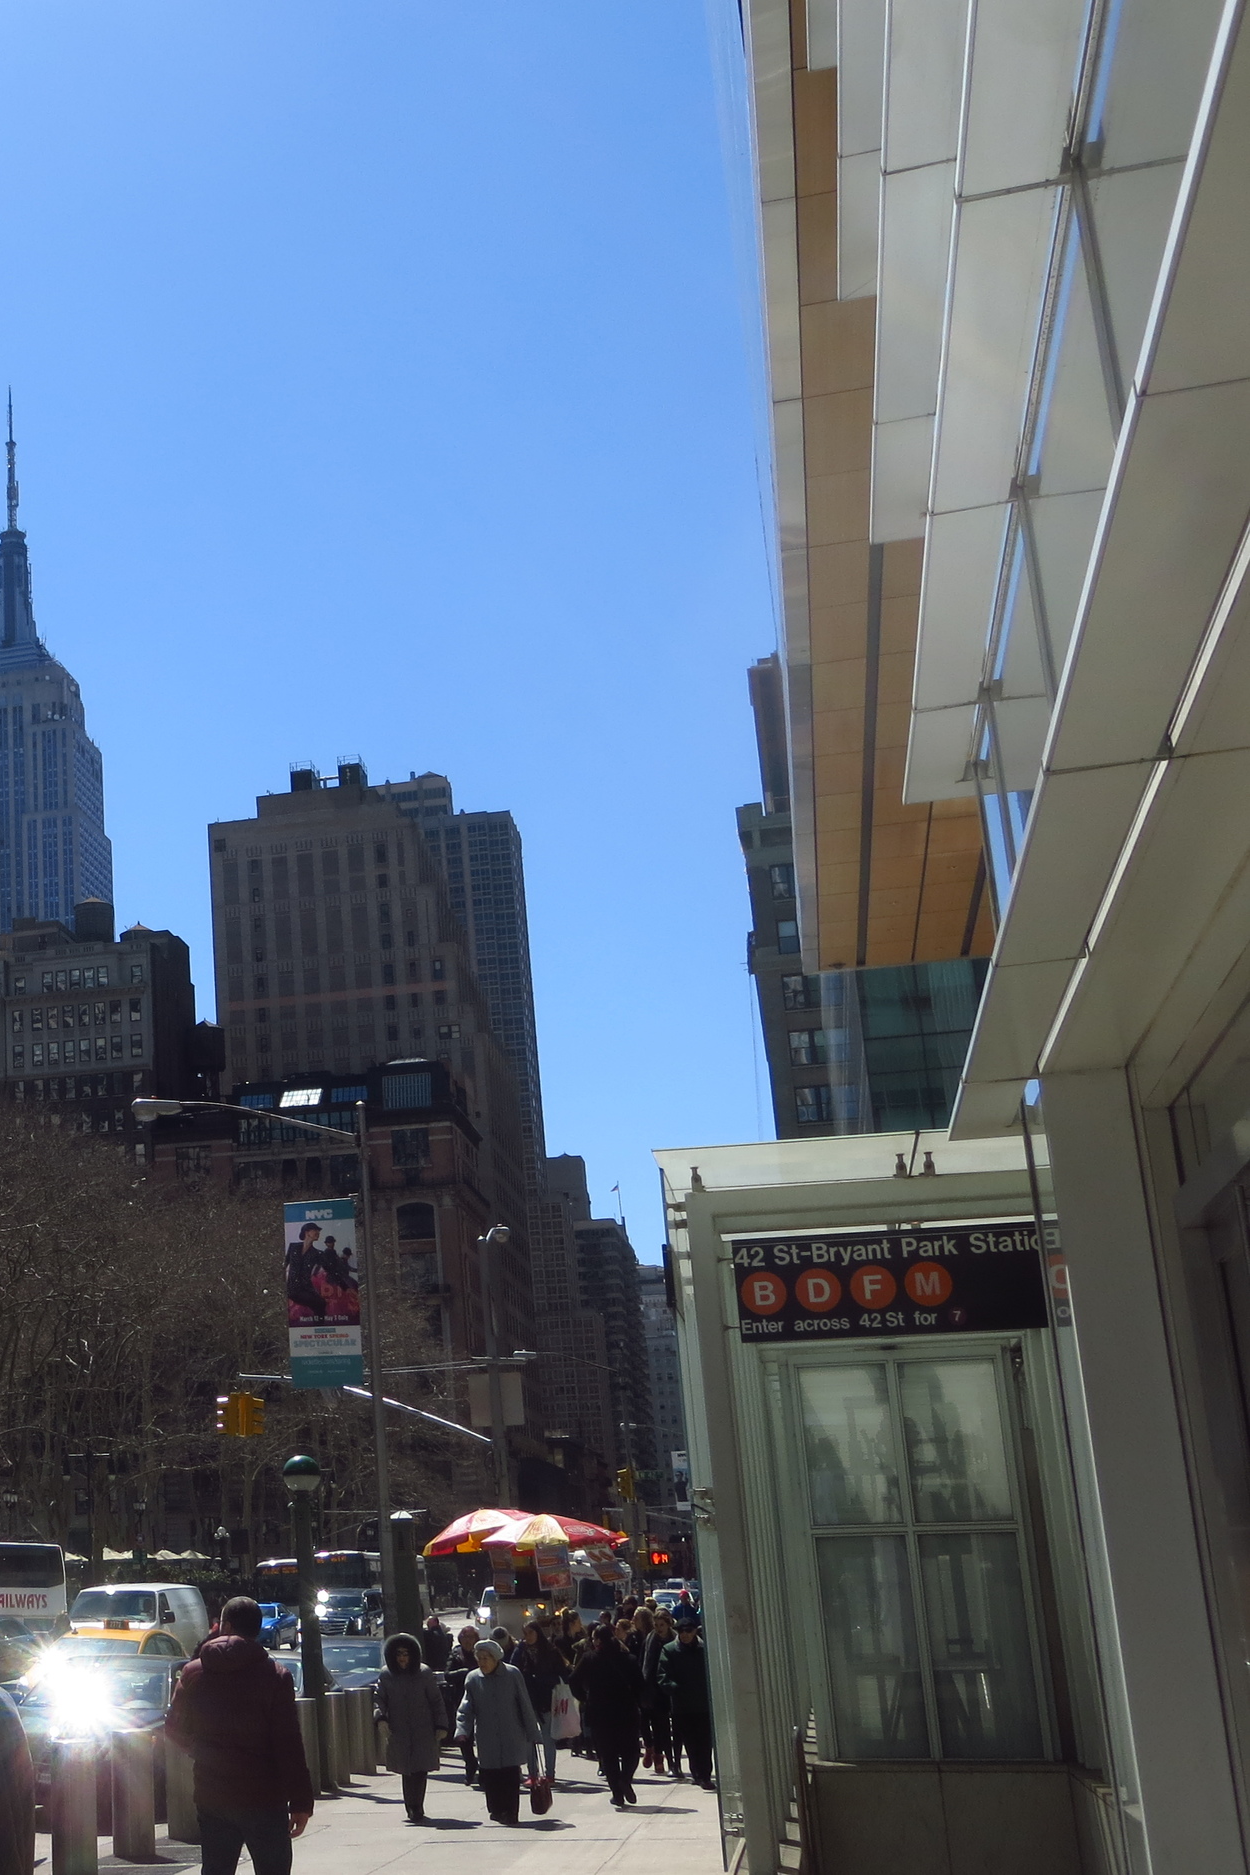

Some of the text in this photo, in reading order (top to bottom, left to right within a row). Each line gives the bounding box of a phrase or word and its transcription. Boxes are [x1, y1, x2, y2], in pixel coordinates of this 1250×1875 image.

[305, 1209, 333, 1220] NYC
[734, 1247, 766, 1267] 42
[773, 1239, 891, 1266] St-Bryant
[901, 1236, 959, 1258] Park
[753, 1271, 941, 1306] B D F M
[741, 1310, 962, 1334] Enter across 42 St for 7
[293, 1339, 357, 1348] SPECTACULAR
